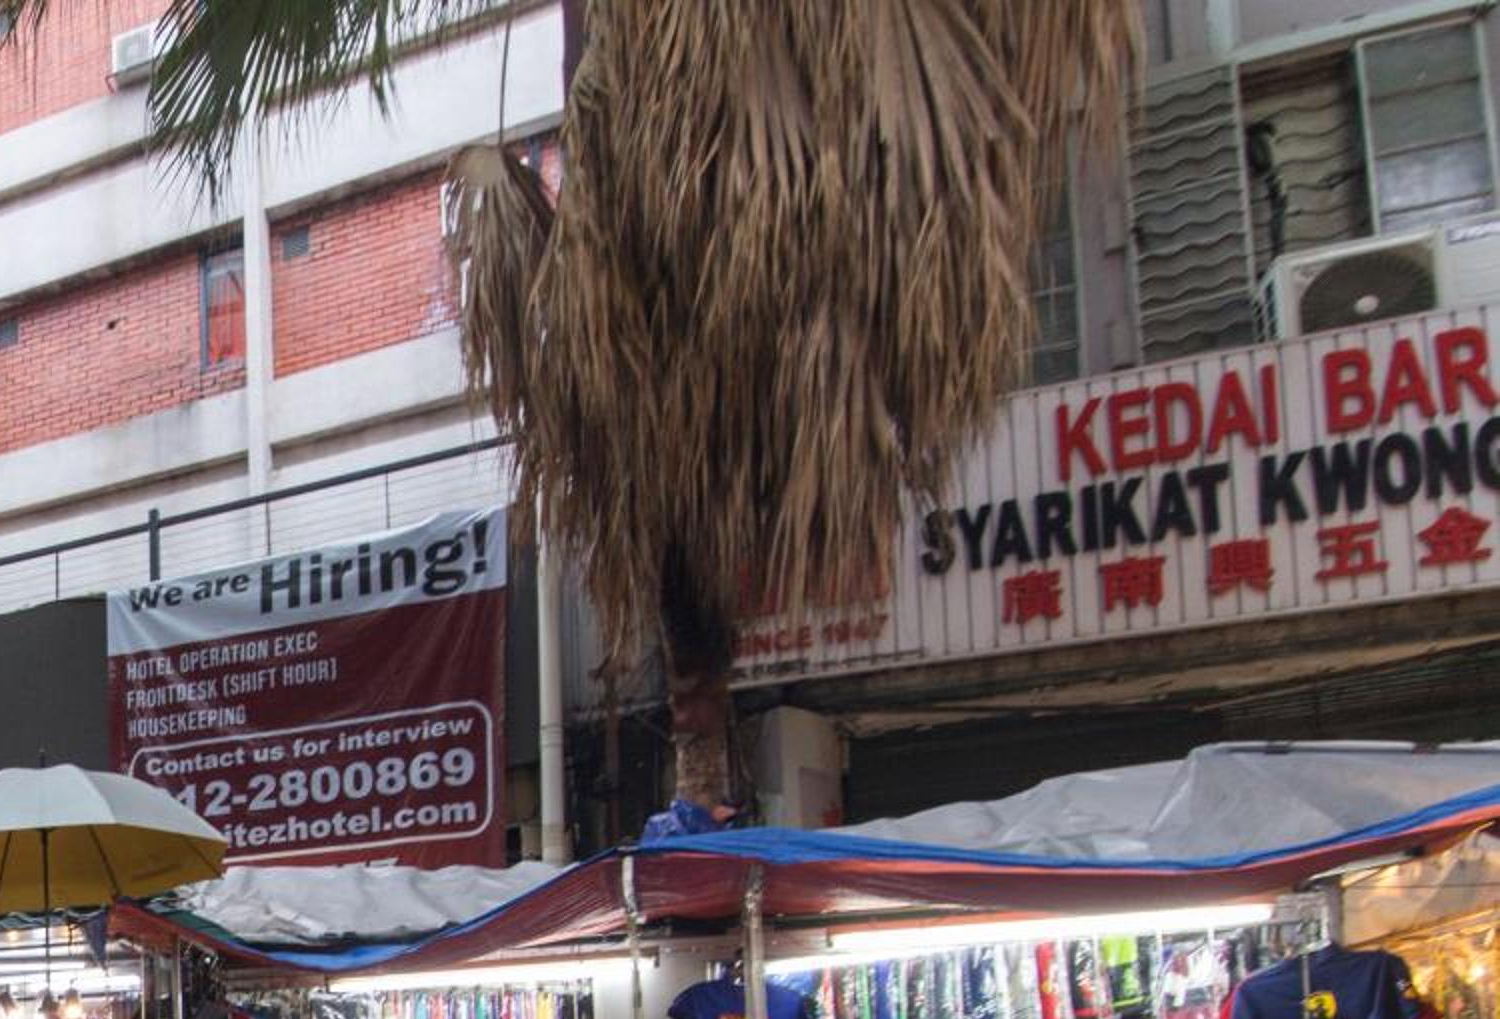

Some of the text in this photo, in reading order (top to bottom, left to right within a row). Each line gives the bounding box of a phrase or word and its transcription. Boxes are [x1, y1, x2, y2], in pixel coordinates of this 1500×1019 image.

[1056, 326, 1500, 483] KEDAI BAR
[922, 463, 1230, 575] SYARIKAT
[129, 519, 490, 614] We are Hiring!
[127, 631, 318, 681] HOTEL OPERATION EXEC
[127, 679, 217, 710] FRONTDESK
[128, 705, 246, 739] HOUSEKEEPING
[145, 715, 474, 776] Contact us for interview
[176, 750, 476, 817] 12-2800869
[223, 801, 476, 849] itezhotel.com
